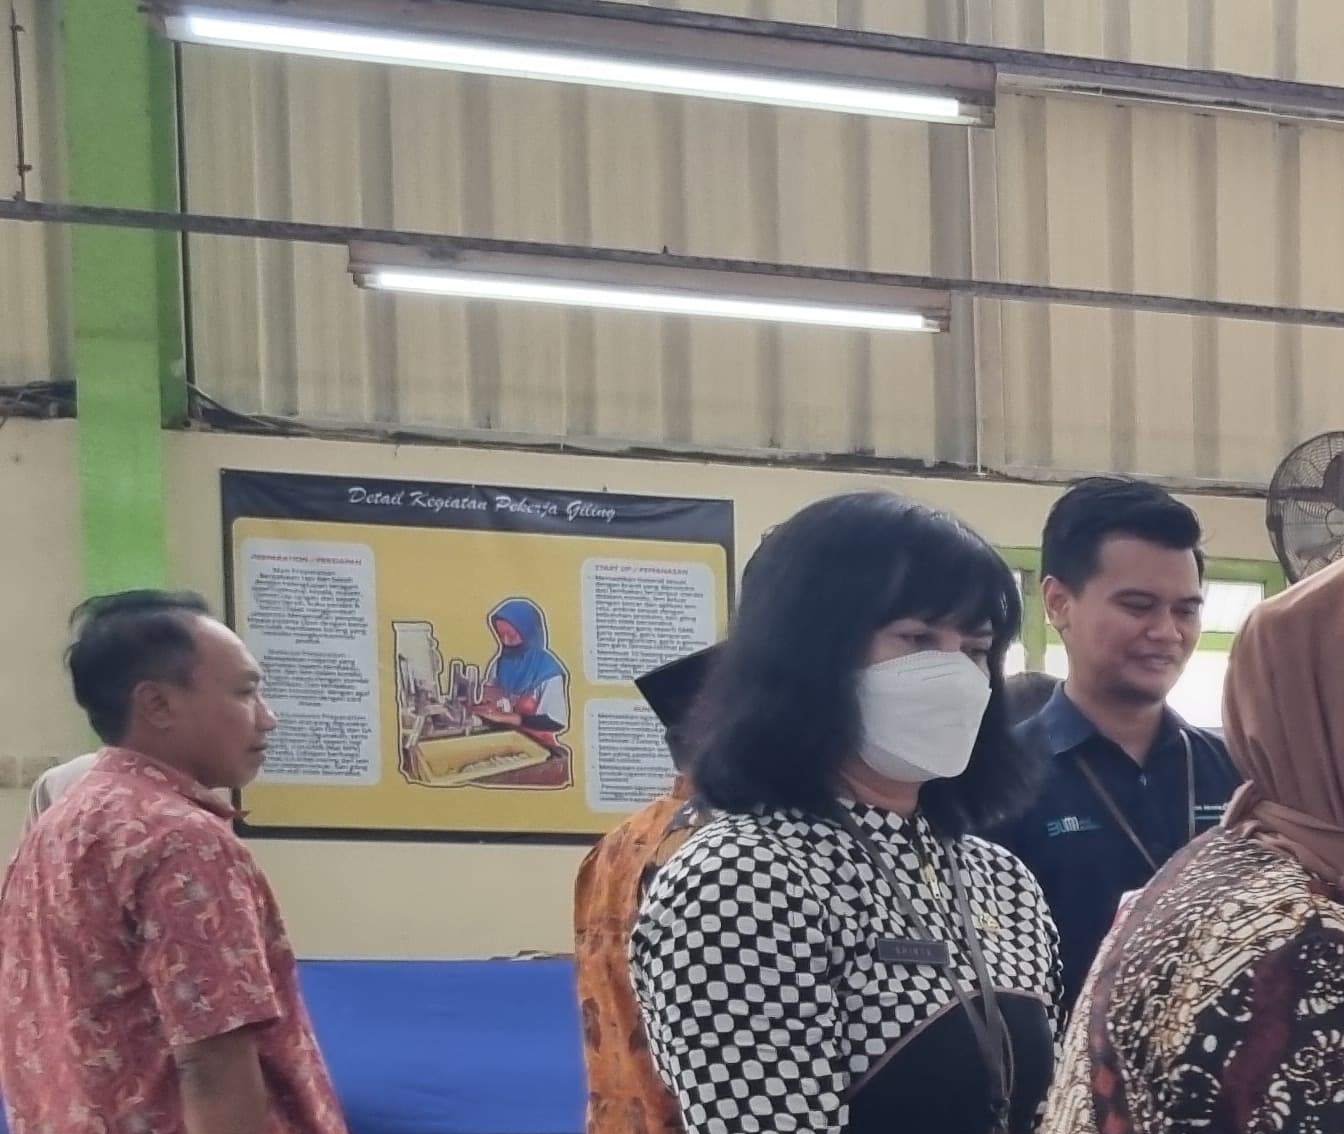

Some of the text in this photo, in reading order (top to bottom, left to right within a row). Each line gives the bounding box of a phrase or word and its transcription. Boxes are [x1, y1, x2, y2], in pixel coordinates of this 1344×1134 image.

[348, 487, 617, 523] Detail Kegiatan Pekerja Giling
